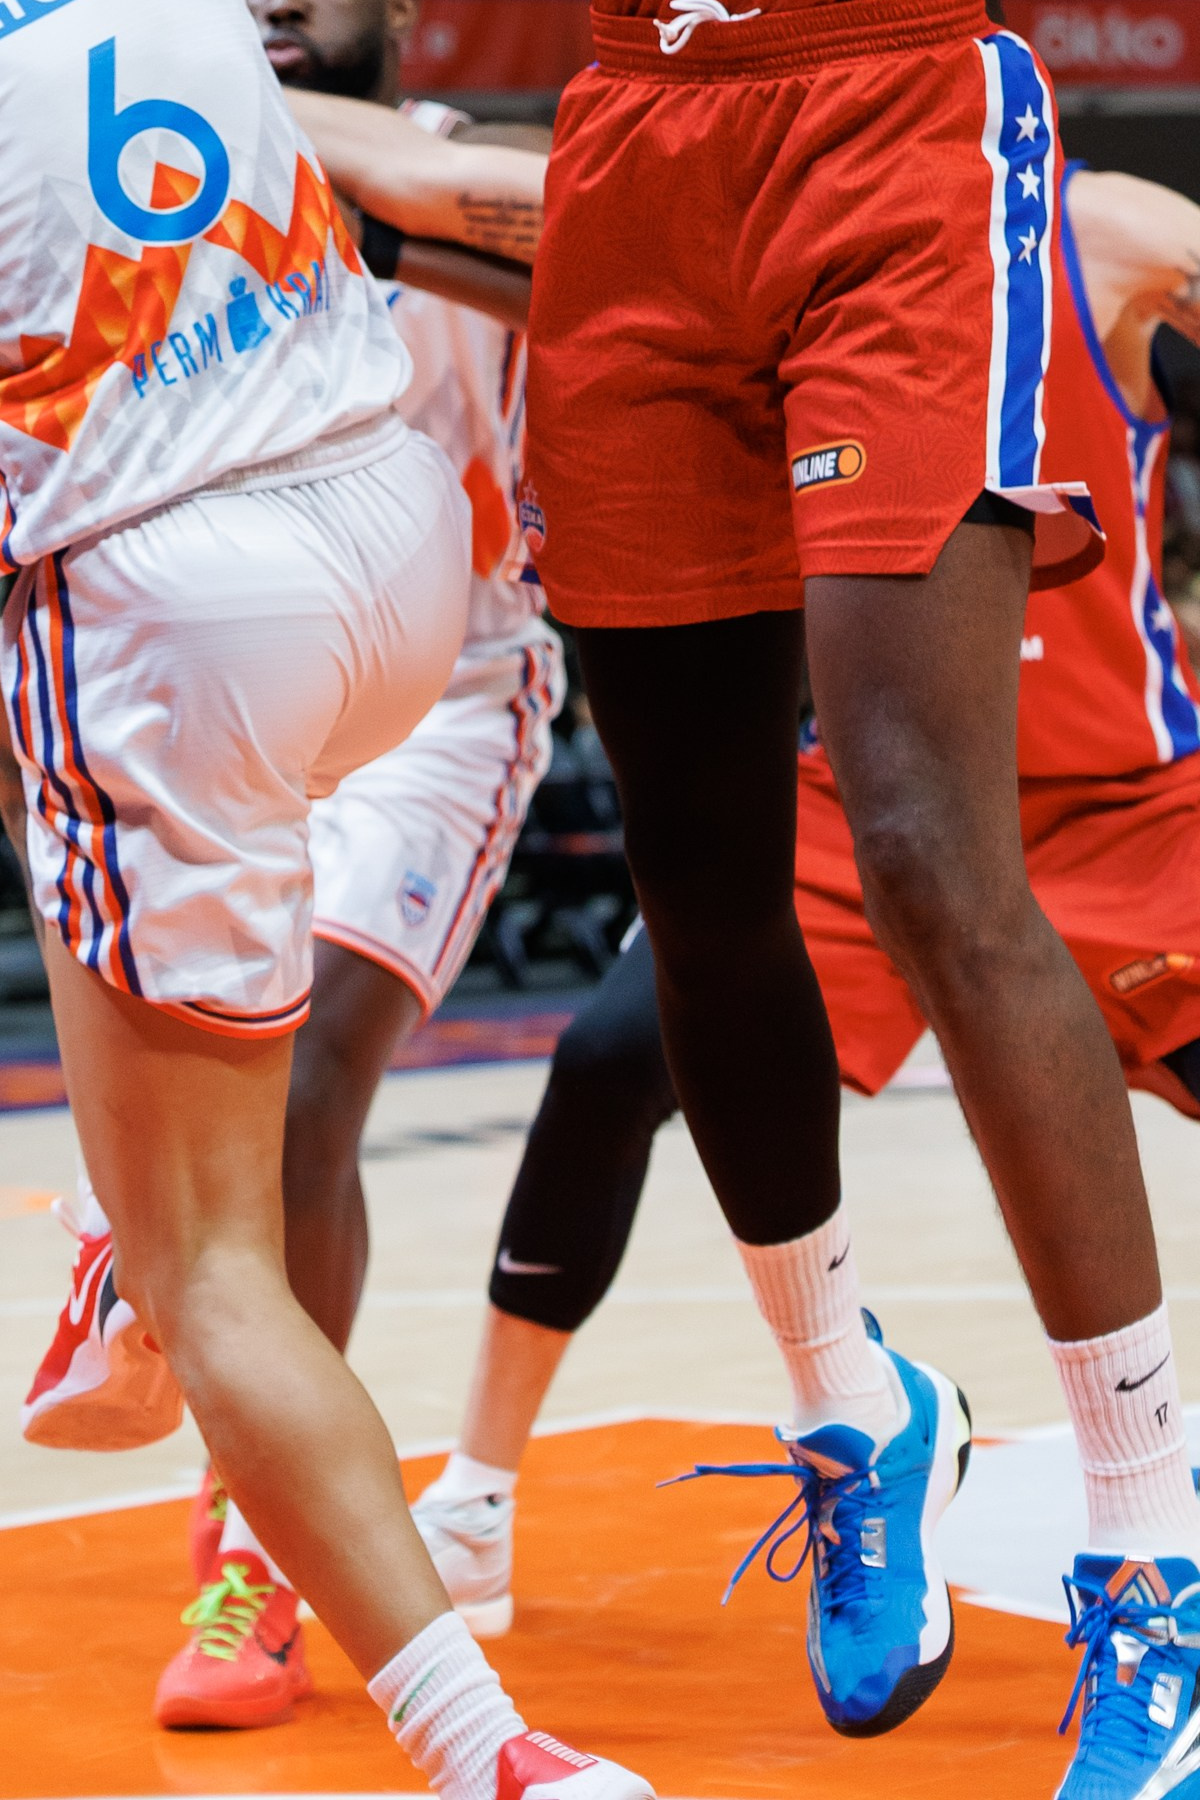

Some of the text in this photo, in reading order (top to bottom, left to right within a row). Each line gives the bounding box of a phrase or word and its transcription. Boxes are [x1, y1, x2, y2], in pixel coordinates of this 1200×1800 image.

[87, 36, 230, 244] 6
[132, 312, 223, 400] PERM
[1154, 1401, 1168, 1428] 17
